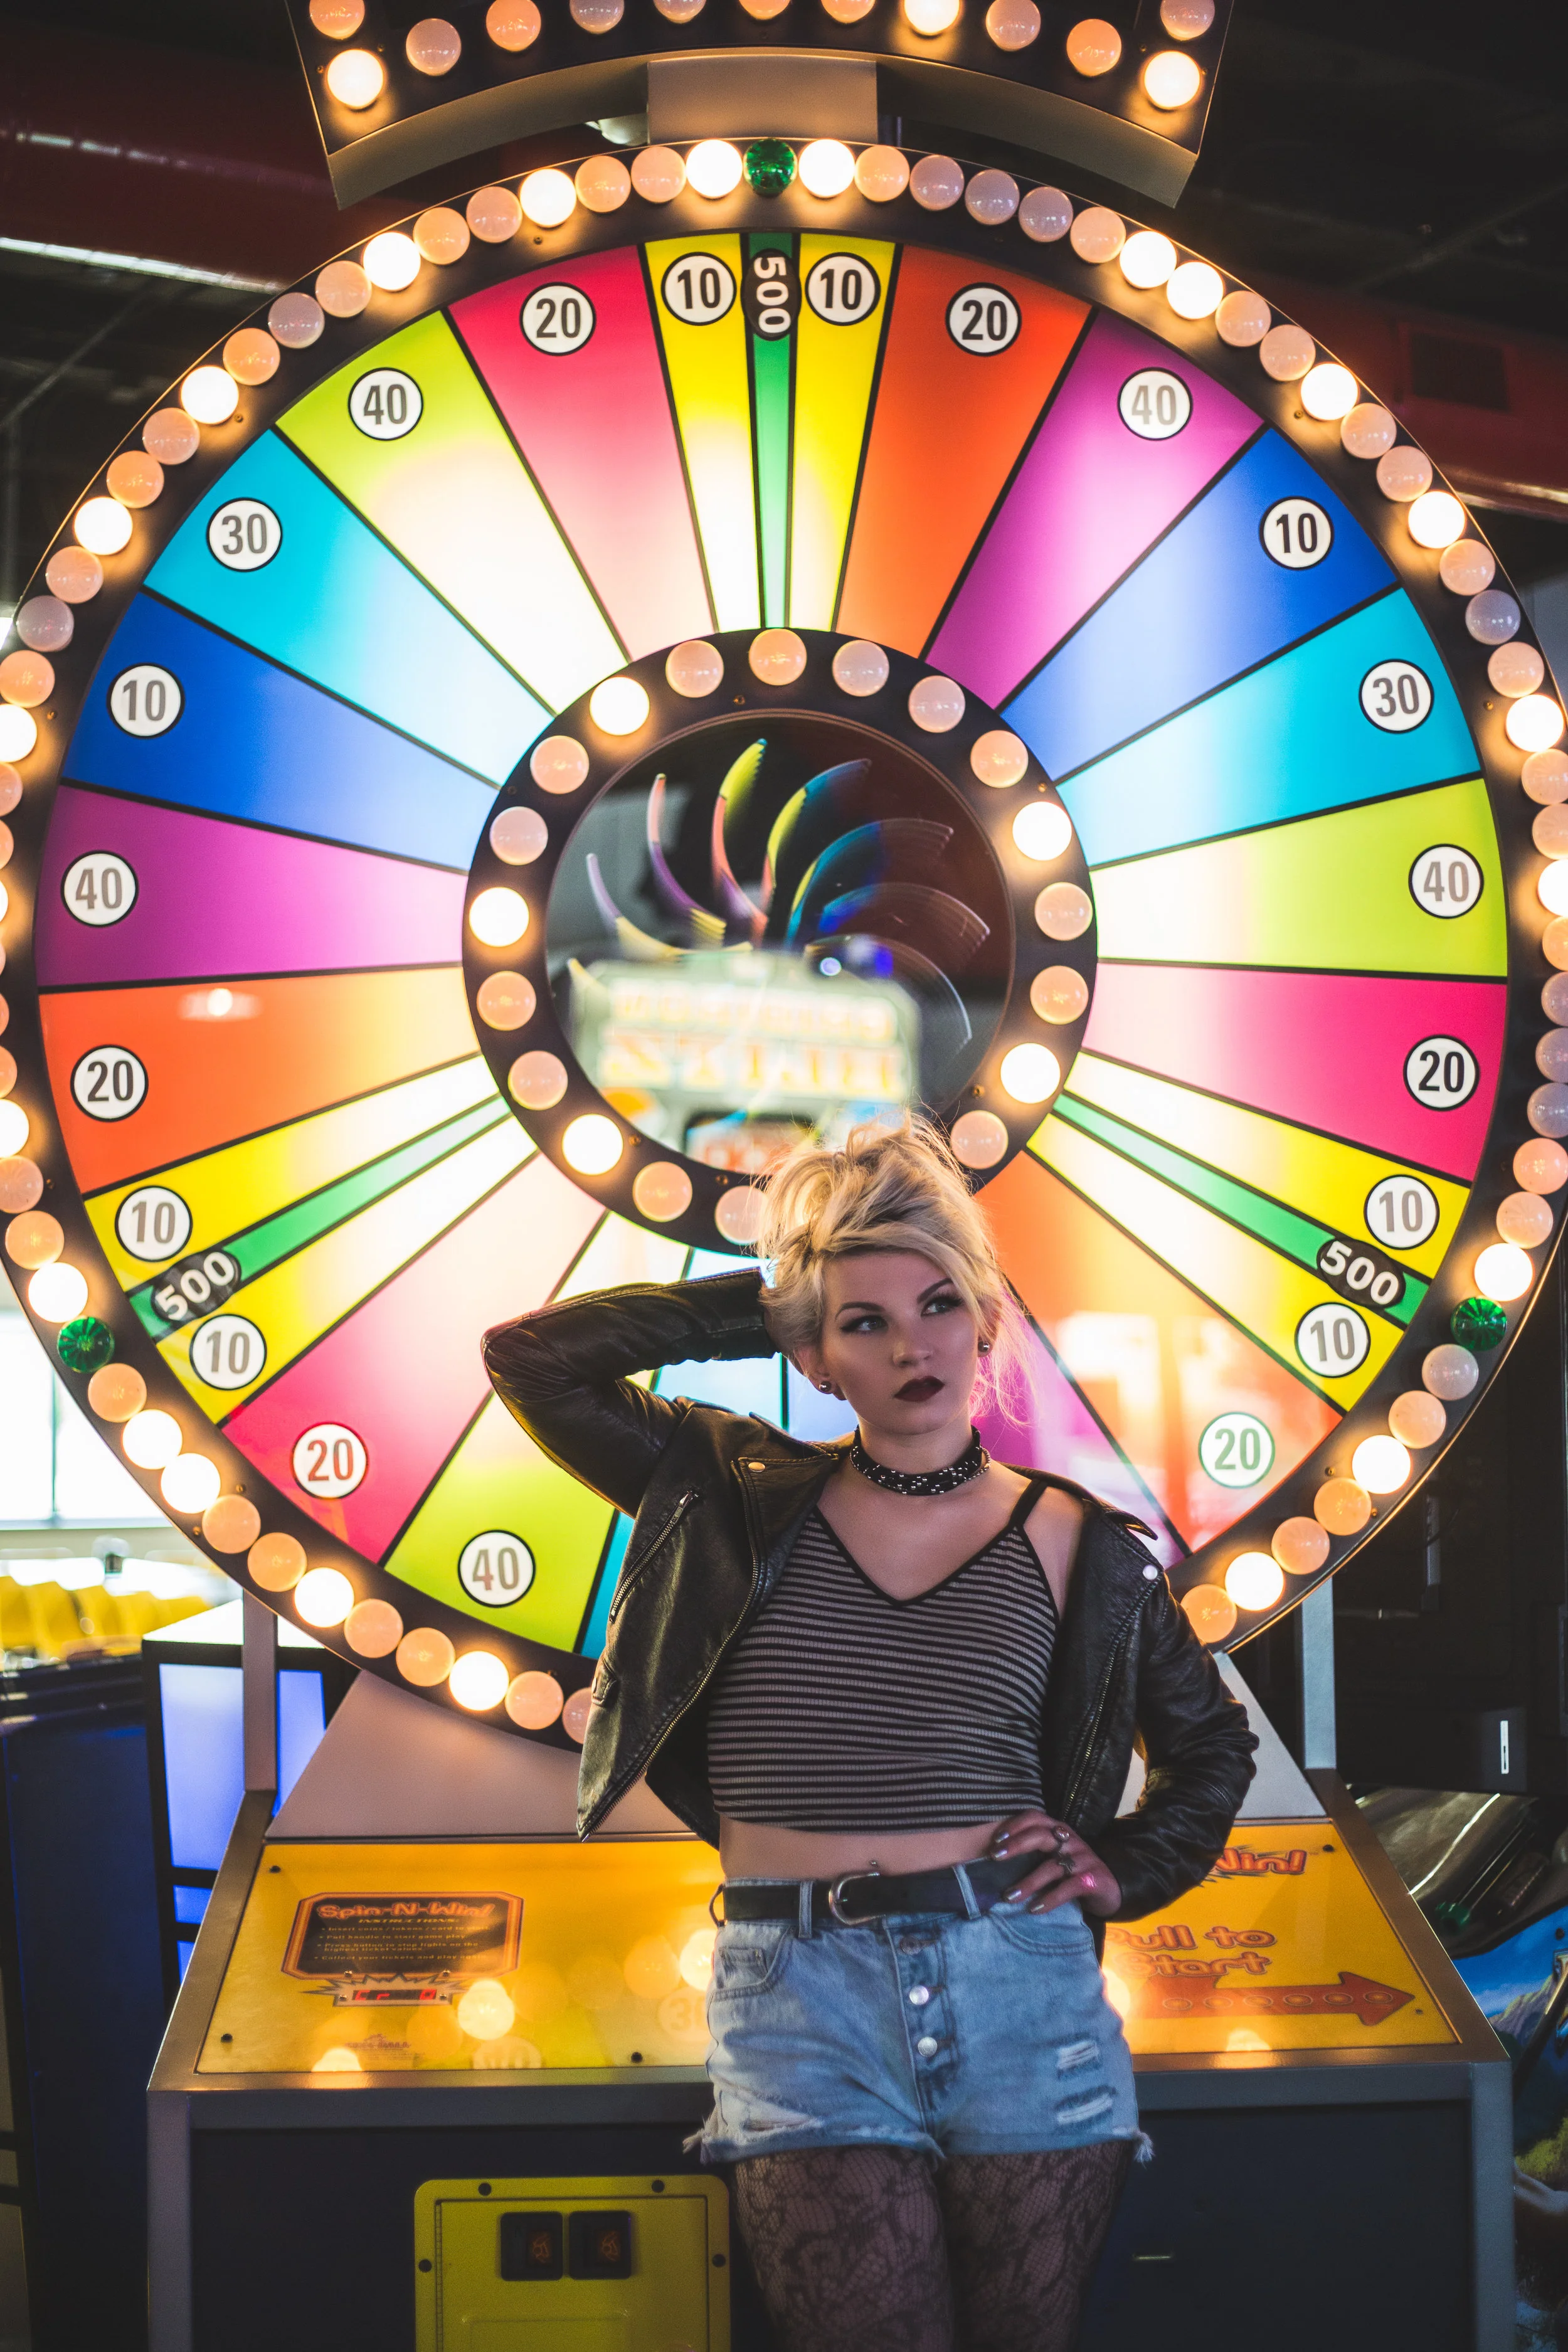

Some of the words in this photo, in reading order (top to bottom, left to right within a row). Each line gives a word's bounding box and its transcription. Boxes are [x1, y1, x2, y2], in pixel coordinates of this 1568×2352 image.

[677, 268, 721, 310] 10
[753, 257, 791, 334] 500
[820, 268, 862, 310] 10
[536, 298, 581, 339] 20
[961, 299, 1008, 341] 20
[363, 384, 407, 425] 40
[1131, 384, 1177, 425] 40
[221, 513, 267, 555] 30
[1276, 512, 1318, 553] 10
[122, 680, 166, 721] 10
[1372, 674, 1419, 717] 30
[75, 867, 122, 910] 40
[1422, 861, 1470, 903] 40
[87, 1060, 134, 1102] 20
[1417, 1050, 1465, 1093] 20
[131, 1201, 176, 1244] 10
[1379, 1190, 1423, 1232] 10
[155, 1252, 235, 1321] 500
[1320, 1241, 1399, 1305] 500
[206, 1330, 250, 1374] 10
[1310, 1318, 1355, 1362] 10
[307, 1439, 354, 1482] 20
[1214, 1428, 1261, 1471] 20
[472, 1547, 519, 1591] 40
[1104, 1926, 1198, 1951] Pull
[1204, 1926, 1277, 1949] to
[1114, 1951, 1273, 1977] Start
[419, 1989, 437, 2000] 0
